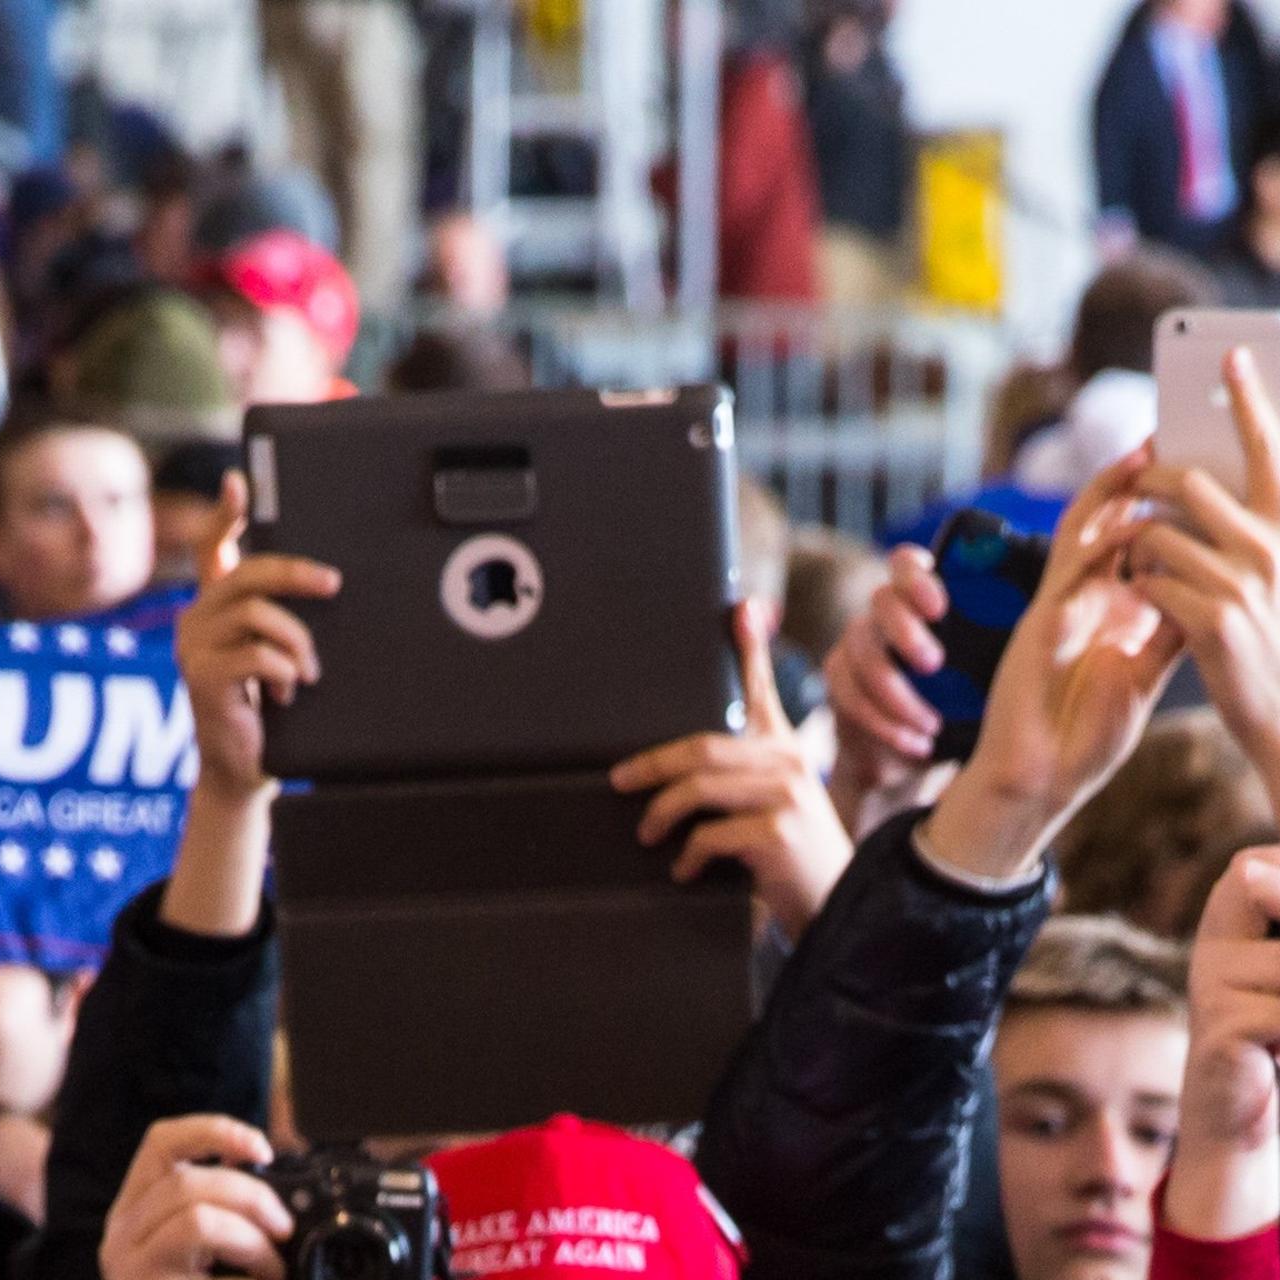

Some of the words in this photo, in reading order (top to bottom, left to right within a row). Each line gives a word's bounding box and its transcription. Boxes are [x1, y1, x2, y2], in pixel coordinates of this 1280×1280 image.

[48, 788, 175, 835] GREAT
[525, 1206, 661, 1244] AMERICA
[554, 1240, 646, 1272] AGAIN
